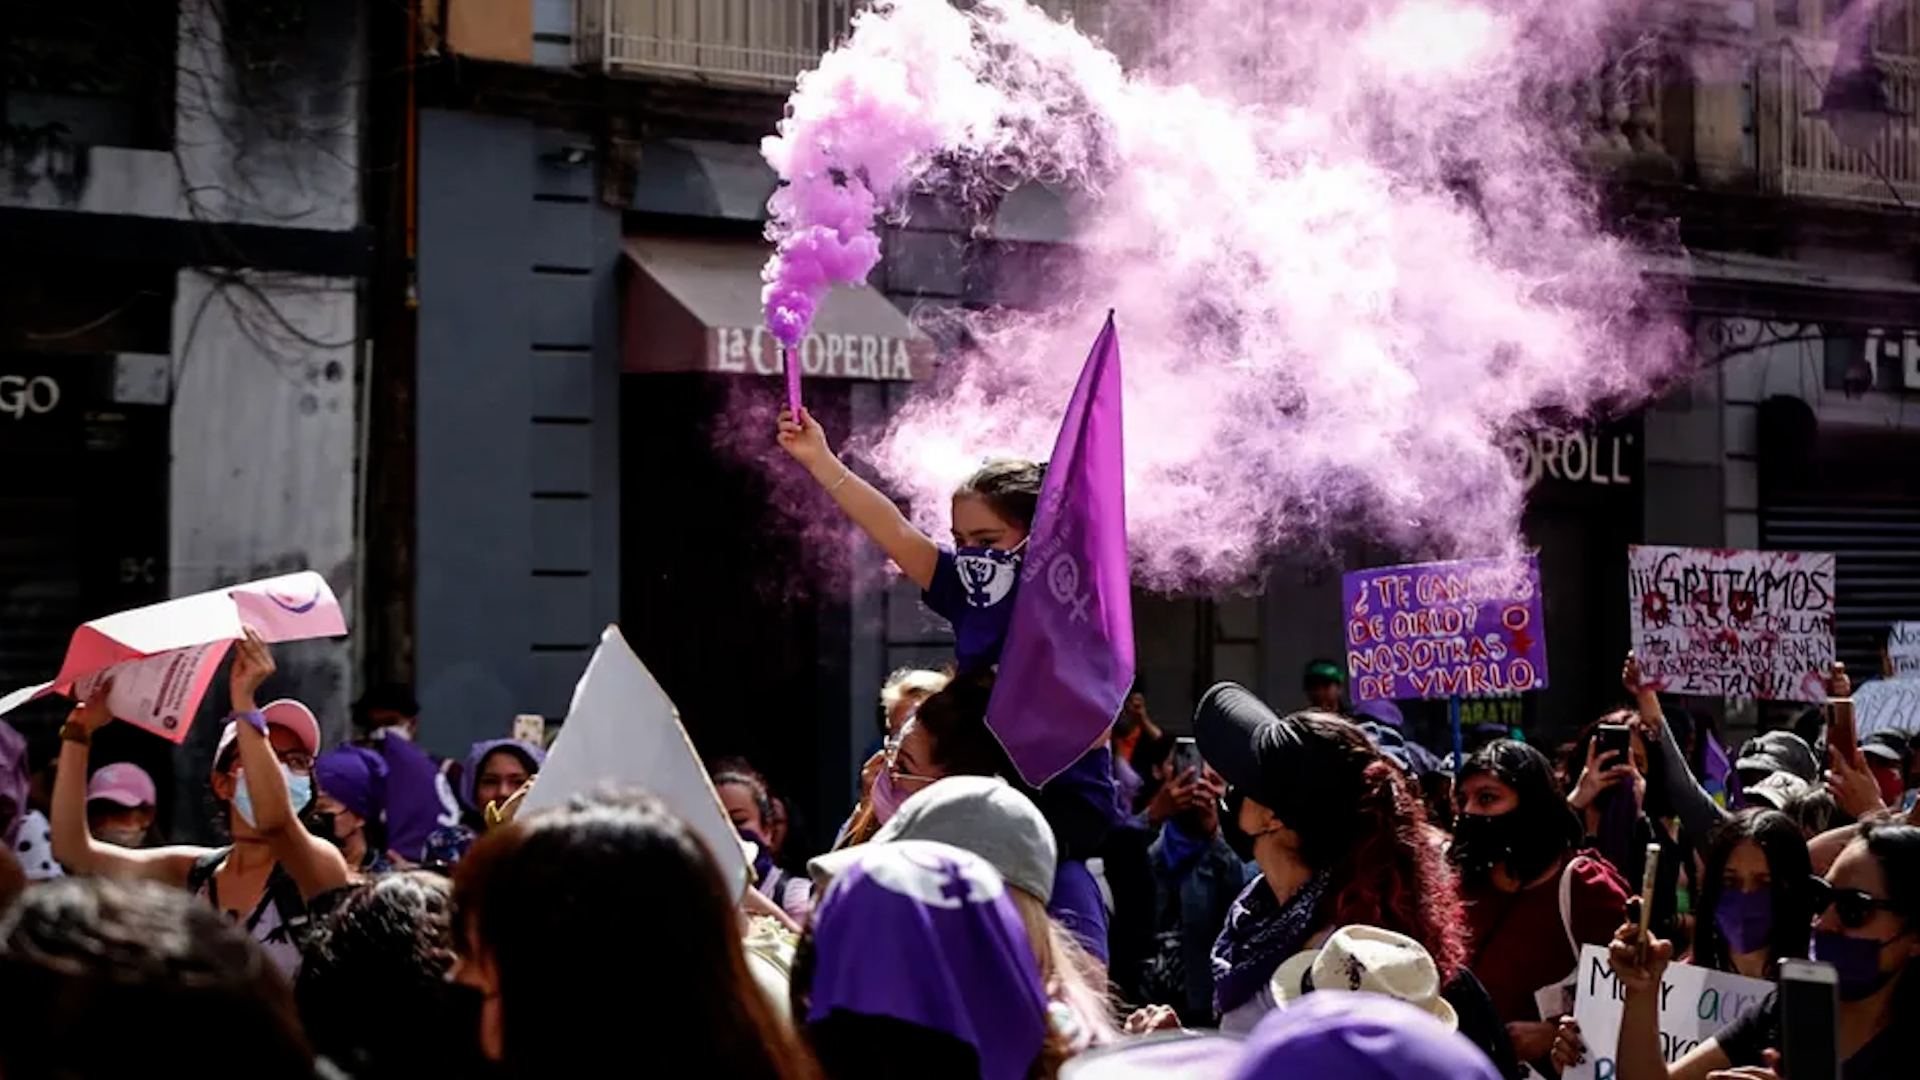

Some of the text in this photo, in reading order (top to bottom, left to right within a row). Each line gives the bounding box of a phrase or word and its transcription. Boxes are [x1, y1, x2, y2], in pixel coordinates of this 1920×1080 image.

[1350, 614, 1386, 645] DE
[1347, 632, 1507, 678] NOSOTRAS
[1359, 671, 1395, 700] DE
